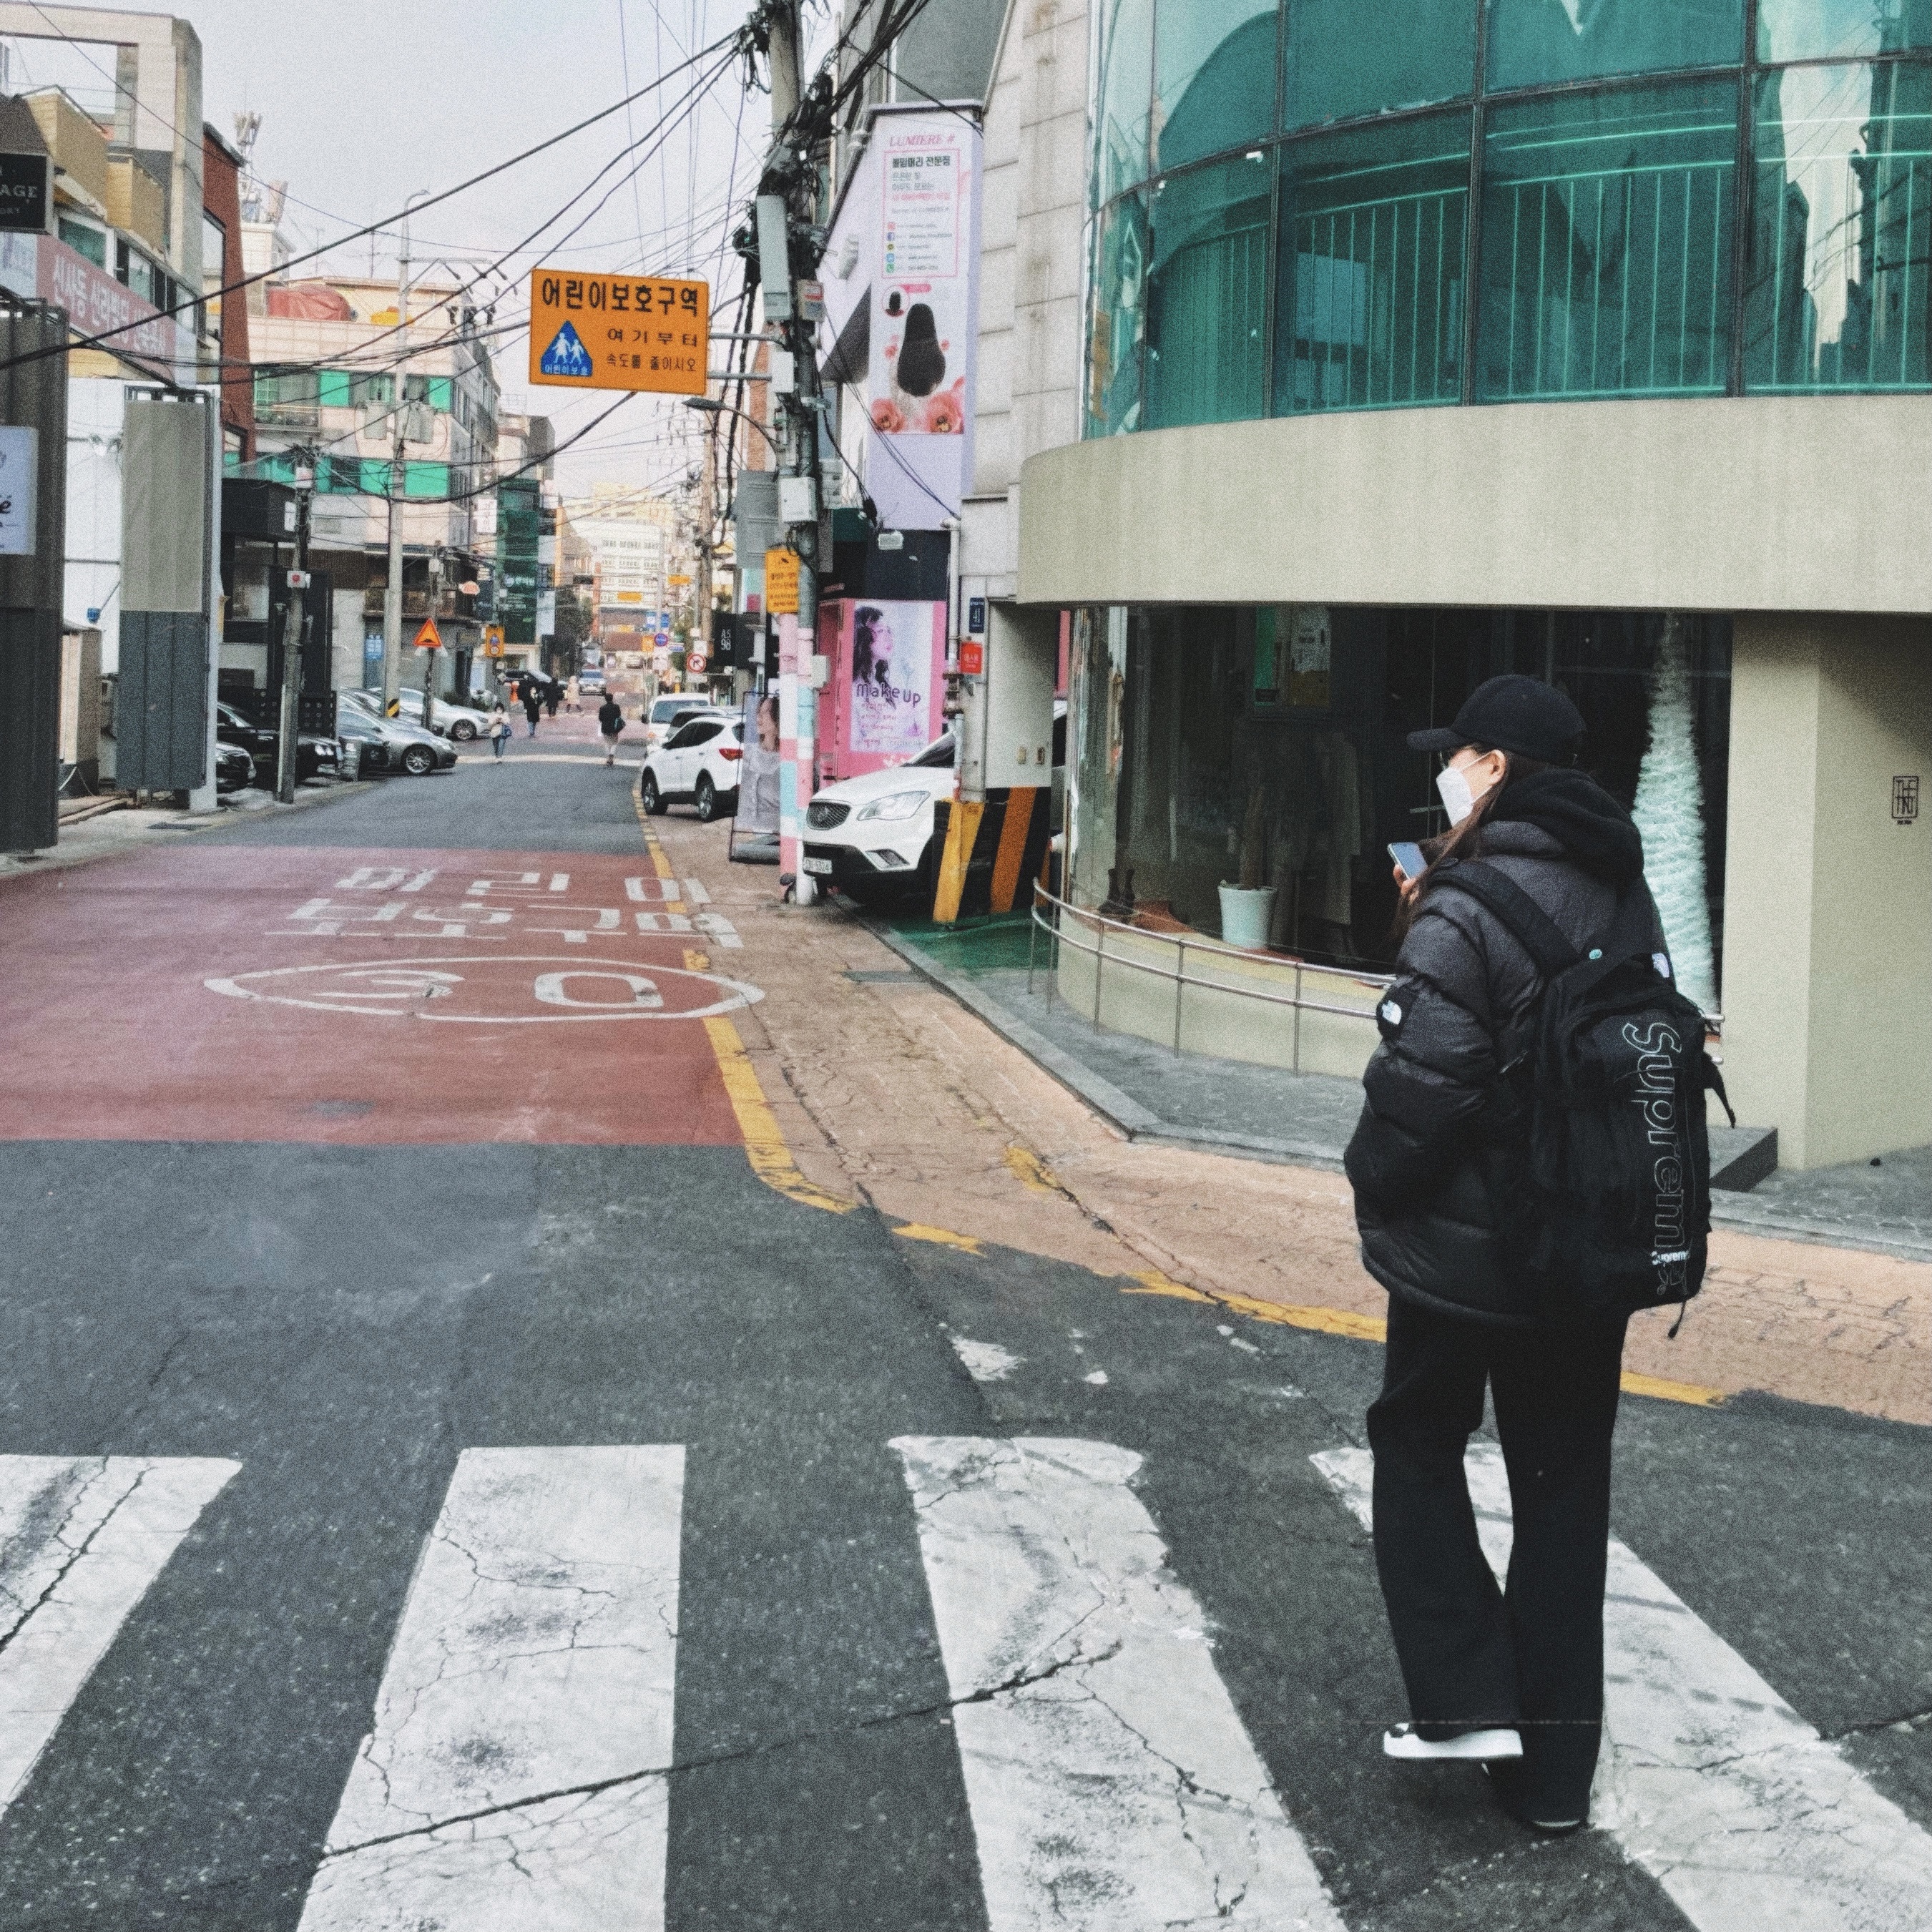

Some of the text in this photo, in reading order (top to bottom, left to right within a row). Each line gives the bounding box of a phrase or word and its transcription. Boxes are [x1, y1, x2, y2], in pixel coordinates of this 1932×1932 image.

[541, 277, 698, 317] 어린이보호구역
[607, 328, 697, 347] 여기부터
[606, 353, 697, 373] 속도를 줄이시오
